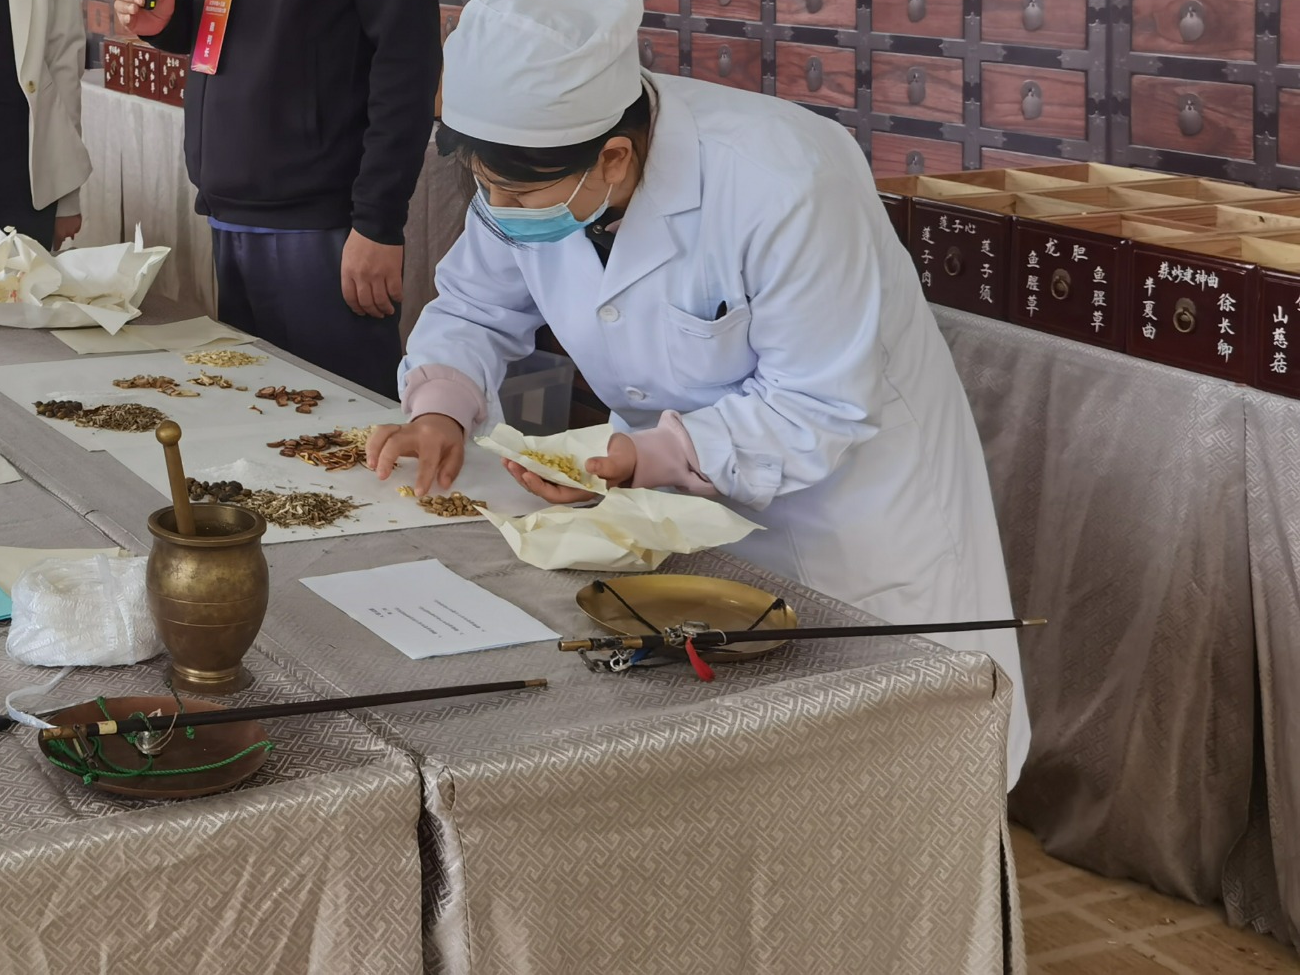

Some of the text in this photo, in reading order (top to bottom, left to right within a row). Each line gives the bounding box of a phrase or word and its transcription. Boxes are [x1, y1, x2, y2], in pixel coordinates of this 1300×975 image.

[1045, 237, 1088, 262] 龙胆
[1026, 250, 1041, 317] 鱼腥草
[1090, 265, 1108, 333] 鱼腥草
[1142, 276, 1158, 339] 半夏曲
[1217, 293, 1236, 363] 徐长卿
